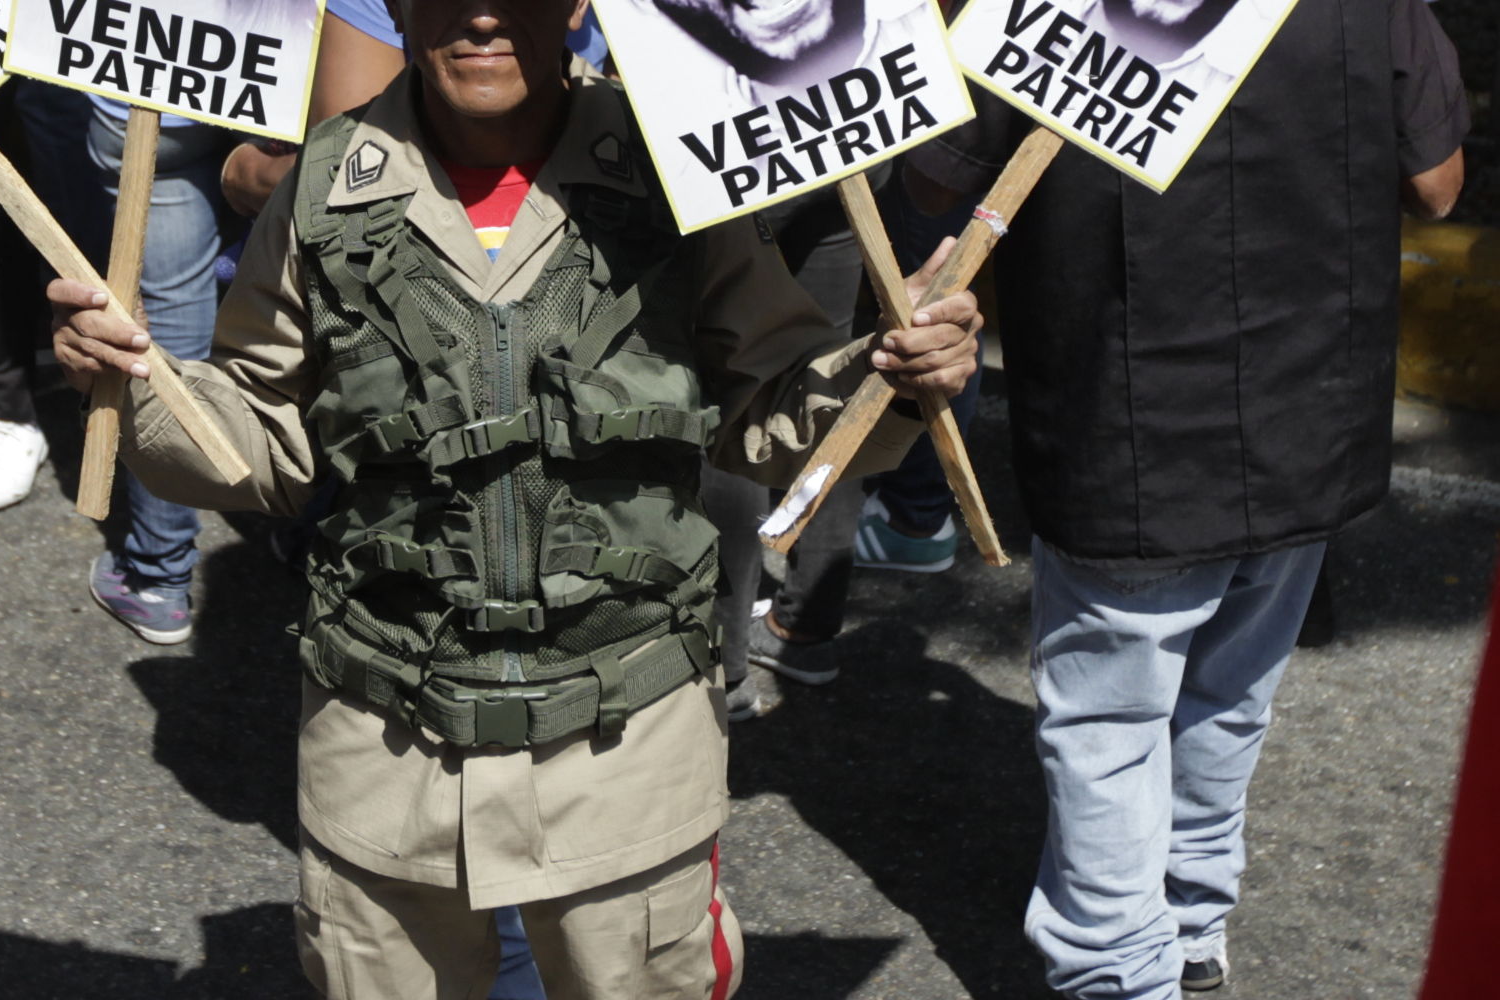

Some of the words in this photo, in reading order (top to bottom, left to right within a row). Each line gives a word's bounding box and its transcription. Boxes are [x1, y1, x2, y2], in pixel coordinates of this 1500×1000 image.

[57, 36, 267, 126] PATRIA
[678, 42, 928, 174] VENDE
[983, 39, 1158, 168] PATRIA
[720, 95, 939, 208] PATRIA
